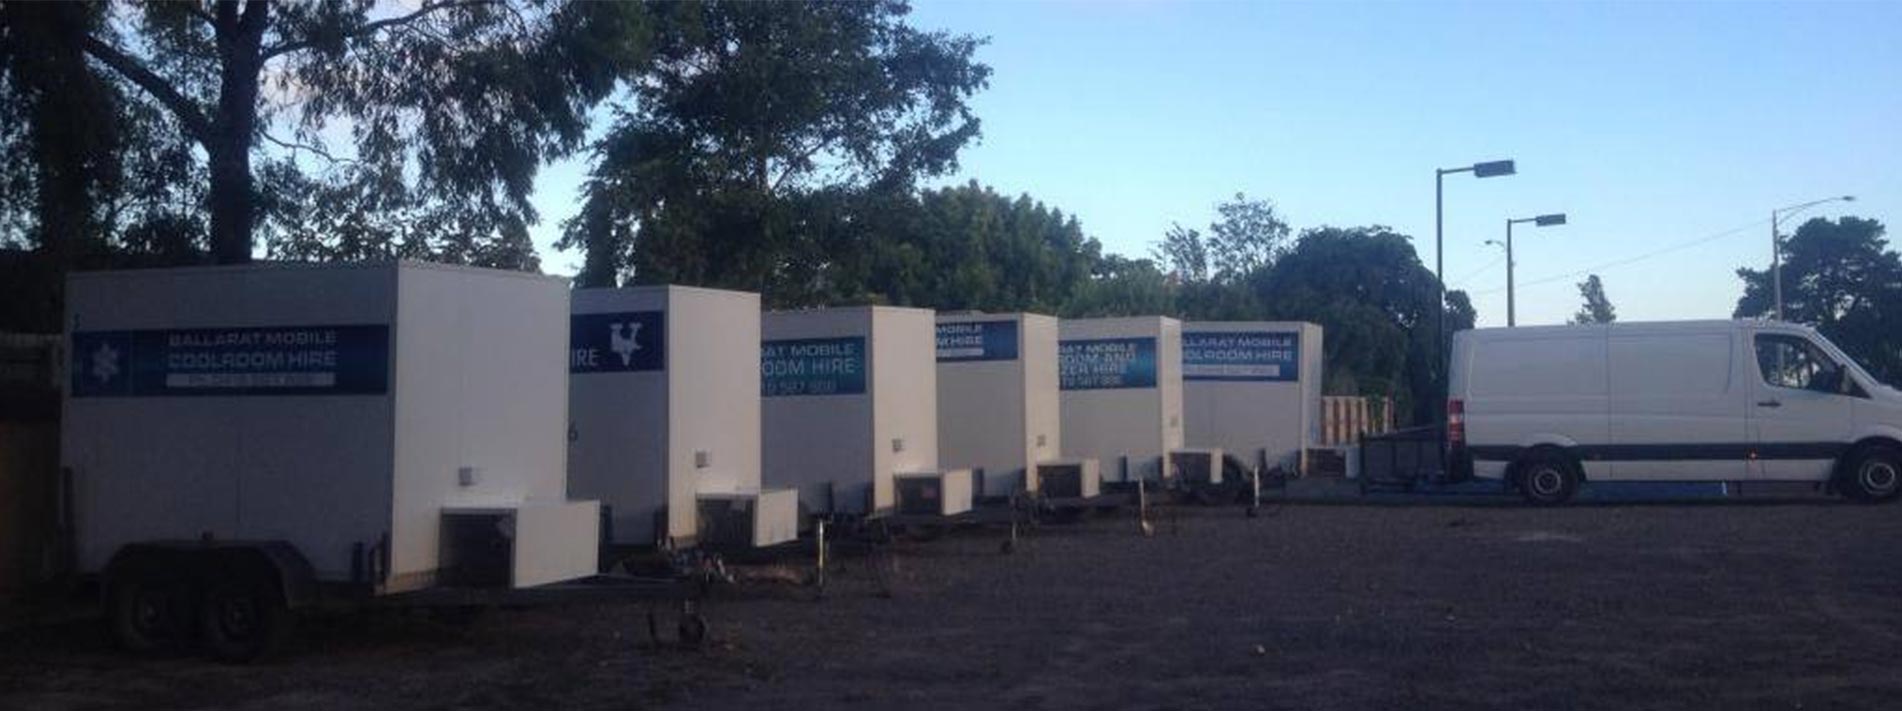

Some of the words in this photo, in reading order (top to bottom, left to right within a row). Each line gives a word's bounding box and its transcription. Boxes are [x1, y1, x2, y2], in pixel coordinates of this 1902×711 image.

[169, 331, 262, 346] BALLARAT
[265, 330, 337, 345] MOBILE
[1237, 336, 1292, 347] MOBILE
[790, 343, 855, 357] MOBILE
[1255, 350, 1293, 361] HIRE
[168, 350, 284, 369] COOLROOM
[287, 350, 337, 368] HIRE
[811, 357, 856, 375] HIRE
